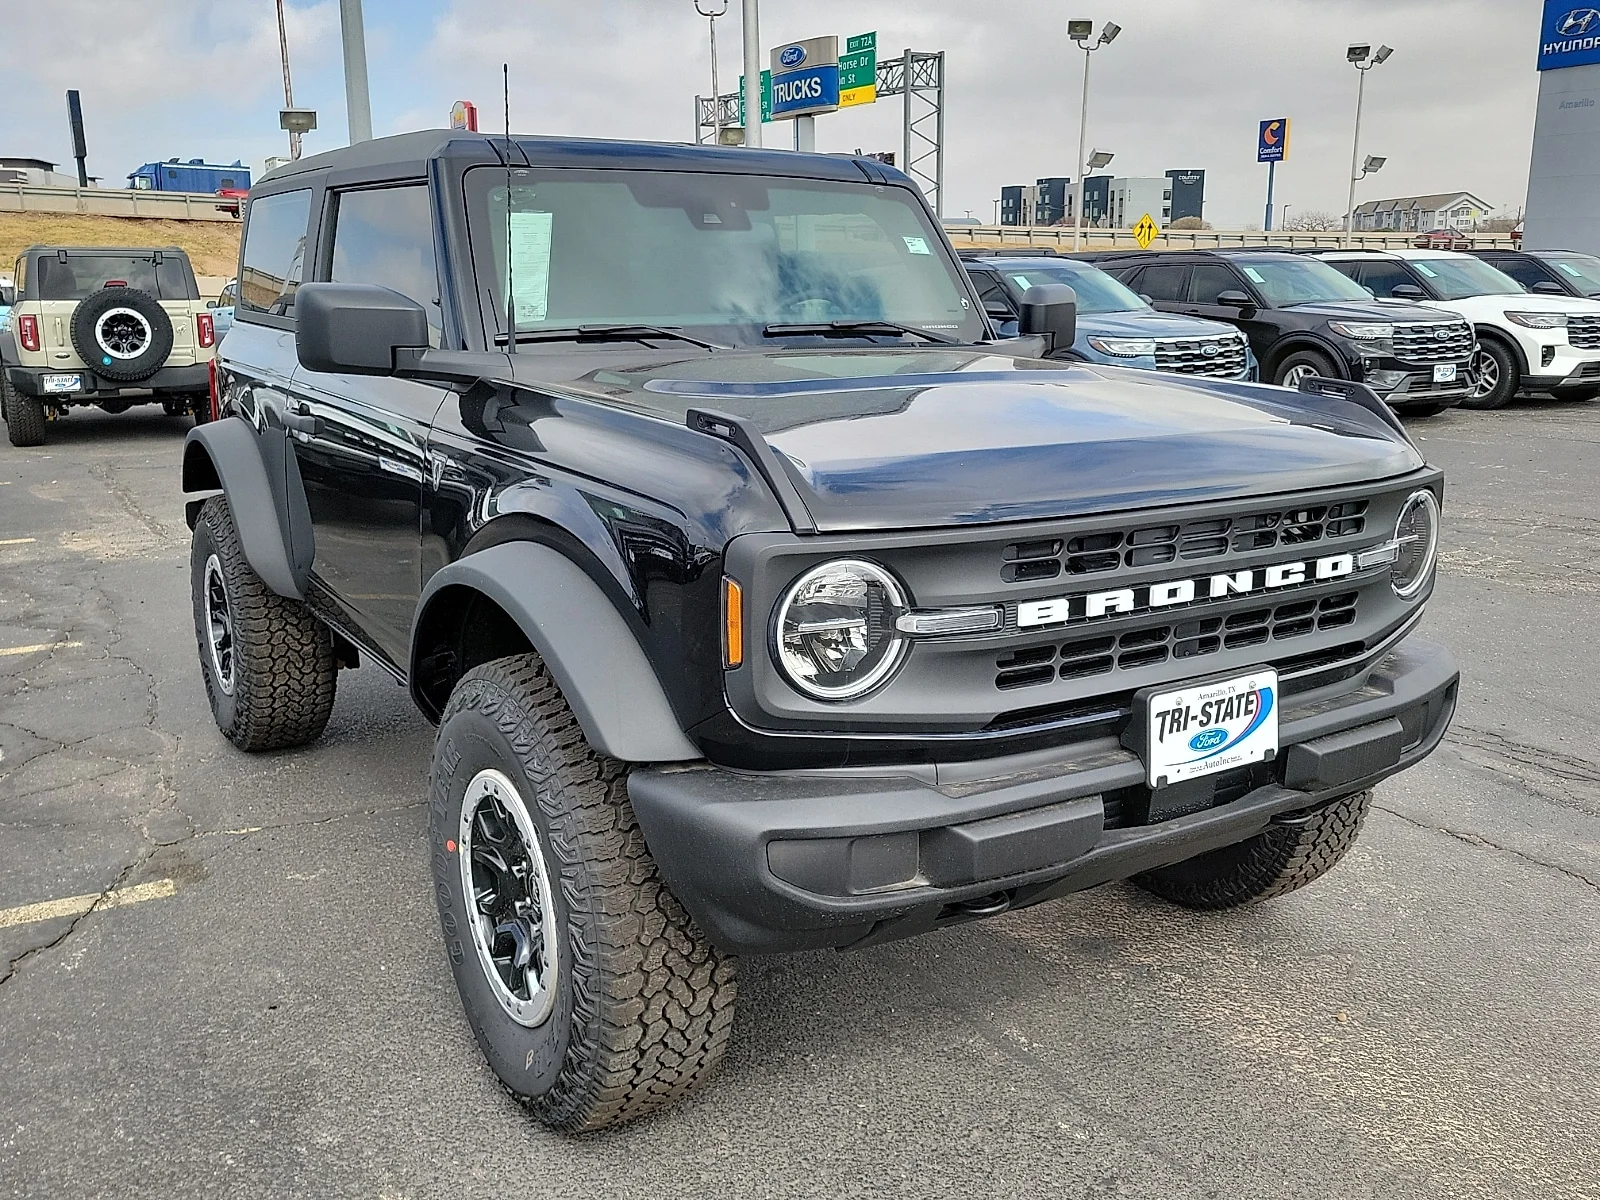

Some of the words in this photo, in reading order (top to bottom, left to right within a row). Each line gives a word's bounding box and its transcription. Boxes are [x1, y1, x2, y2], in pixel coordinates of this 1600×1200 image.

[860, 36, 873, 47] 72A
[1543, 36, 1600, 55] HYUNDA
[860, 56, 869, 67] Dr
[848, 73, 856, 84] St
[773, 76, 822, 105] TRUCKS
[842, 93, 856, 102] ONLY
[1558, 97, 1595, 110] Amarillo
[1259, 146, 1283, 154] Comfort
[1016, 553, 1354, 628] BRONCO
[1197, 688, 1228, 701] Amarillo,
[1227, 685, 1236, 695] TX
[1155, 691, 1257, 744] TRI-STATE
[1196, 731, 1222, 749] Ford
